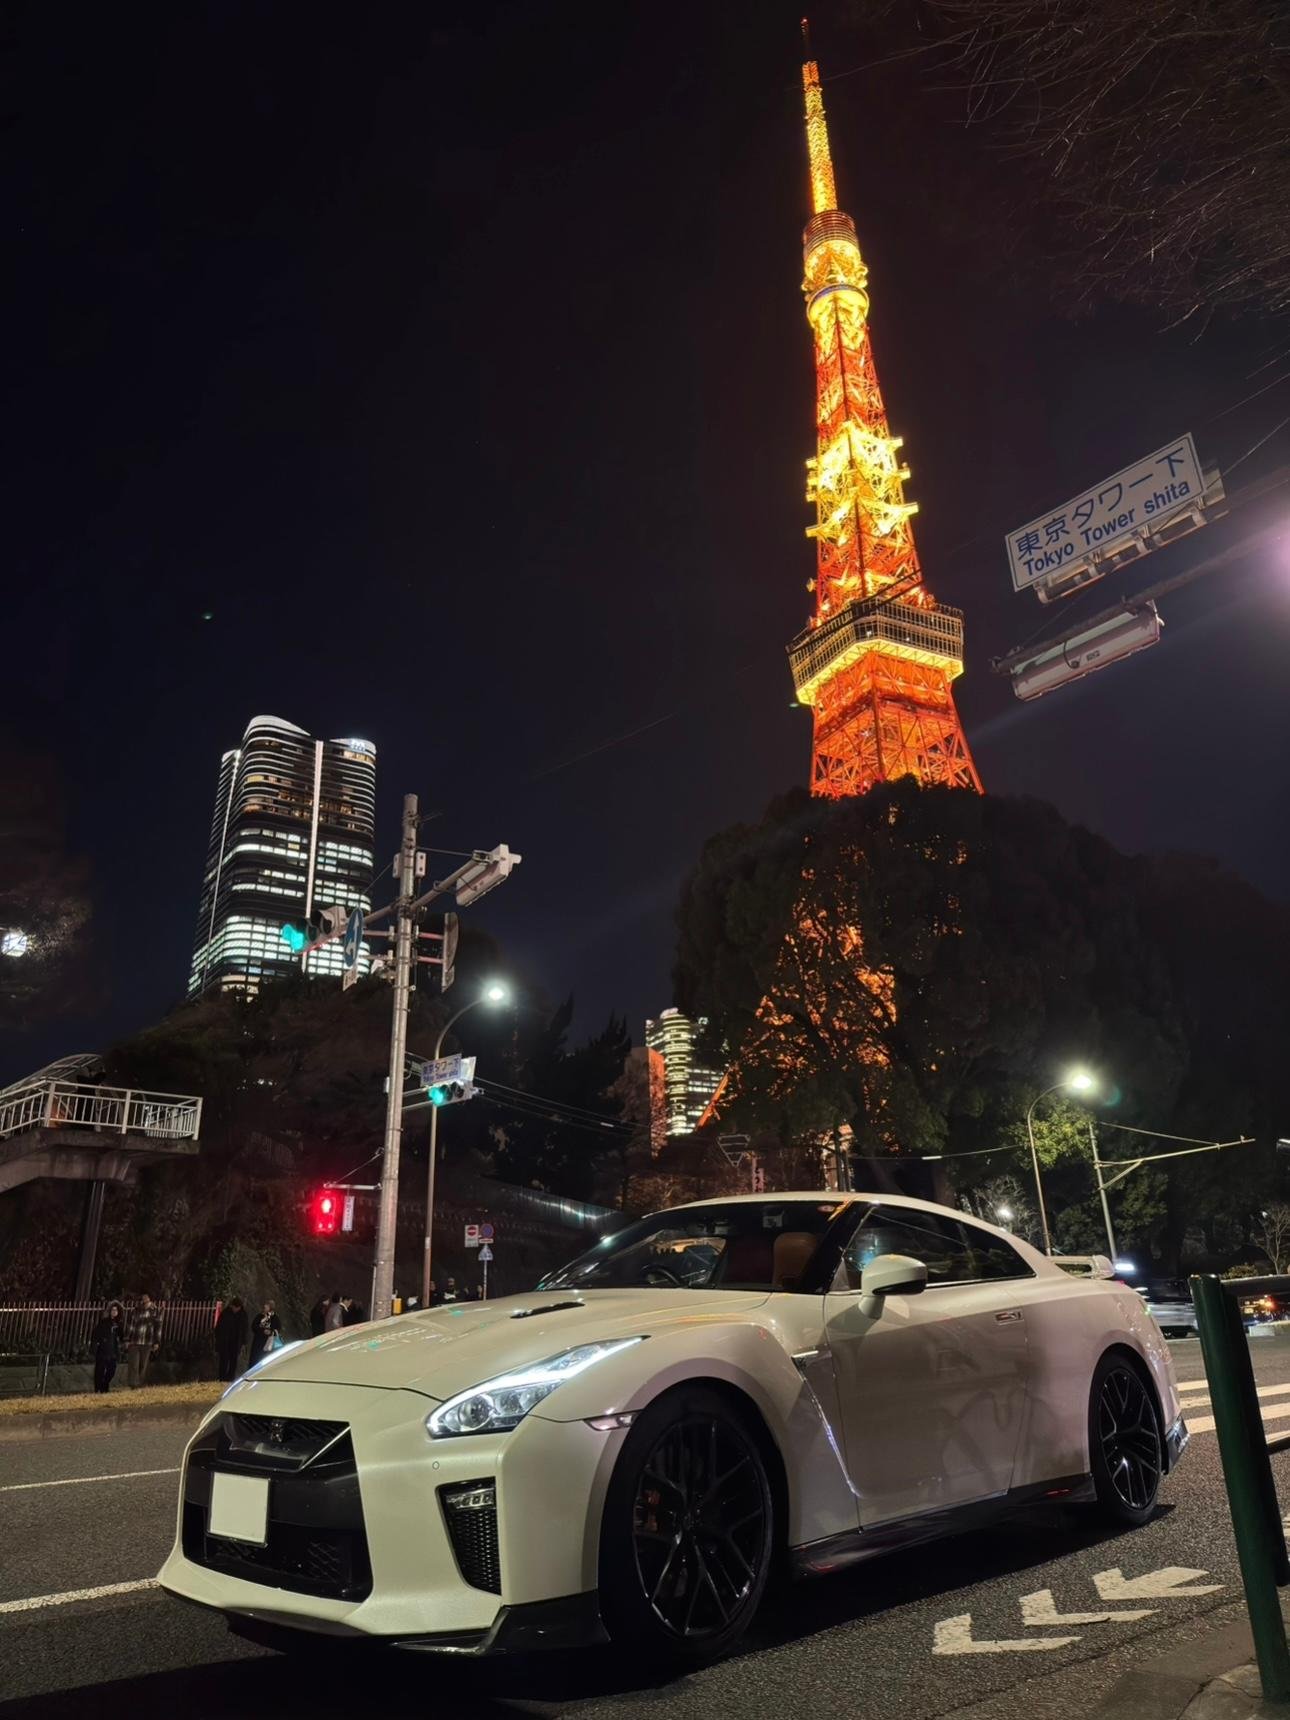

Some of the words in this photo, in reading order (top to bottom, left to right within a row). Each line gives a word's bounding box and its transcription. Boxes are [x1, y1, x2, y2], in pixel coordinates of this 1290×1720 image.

[1016, 447, 1184, 560] 東京タワー下
[1023, 543, 1074, 575] Tokyo
[1080, 508, 1135, 545] Tower
[1144, 481, 1190, 514] shita
